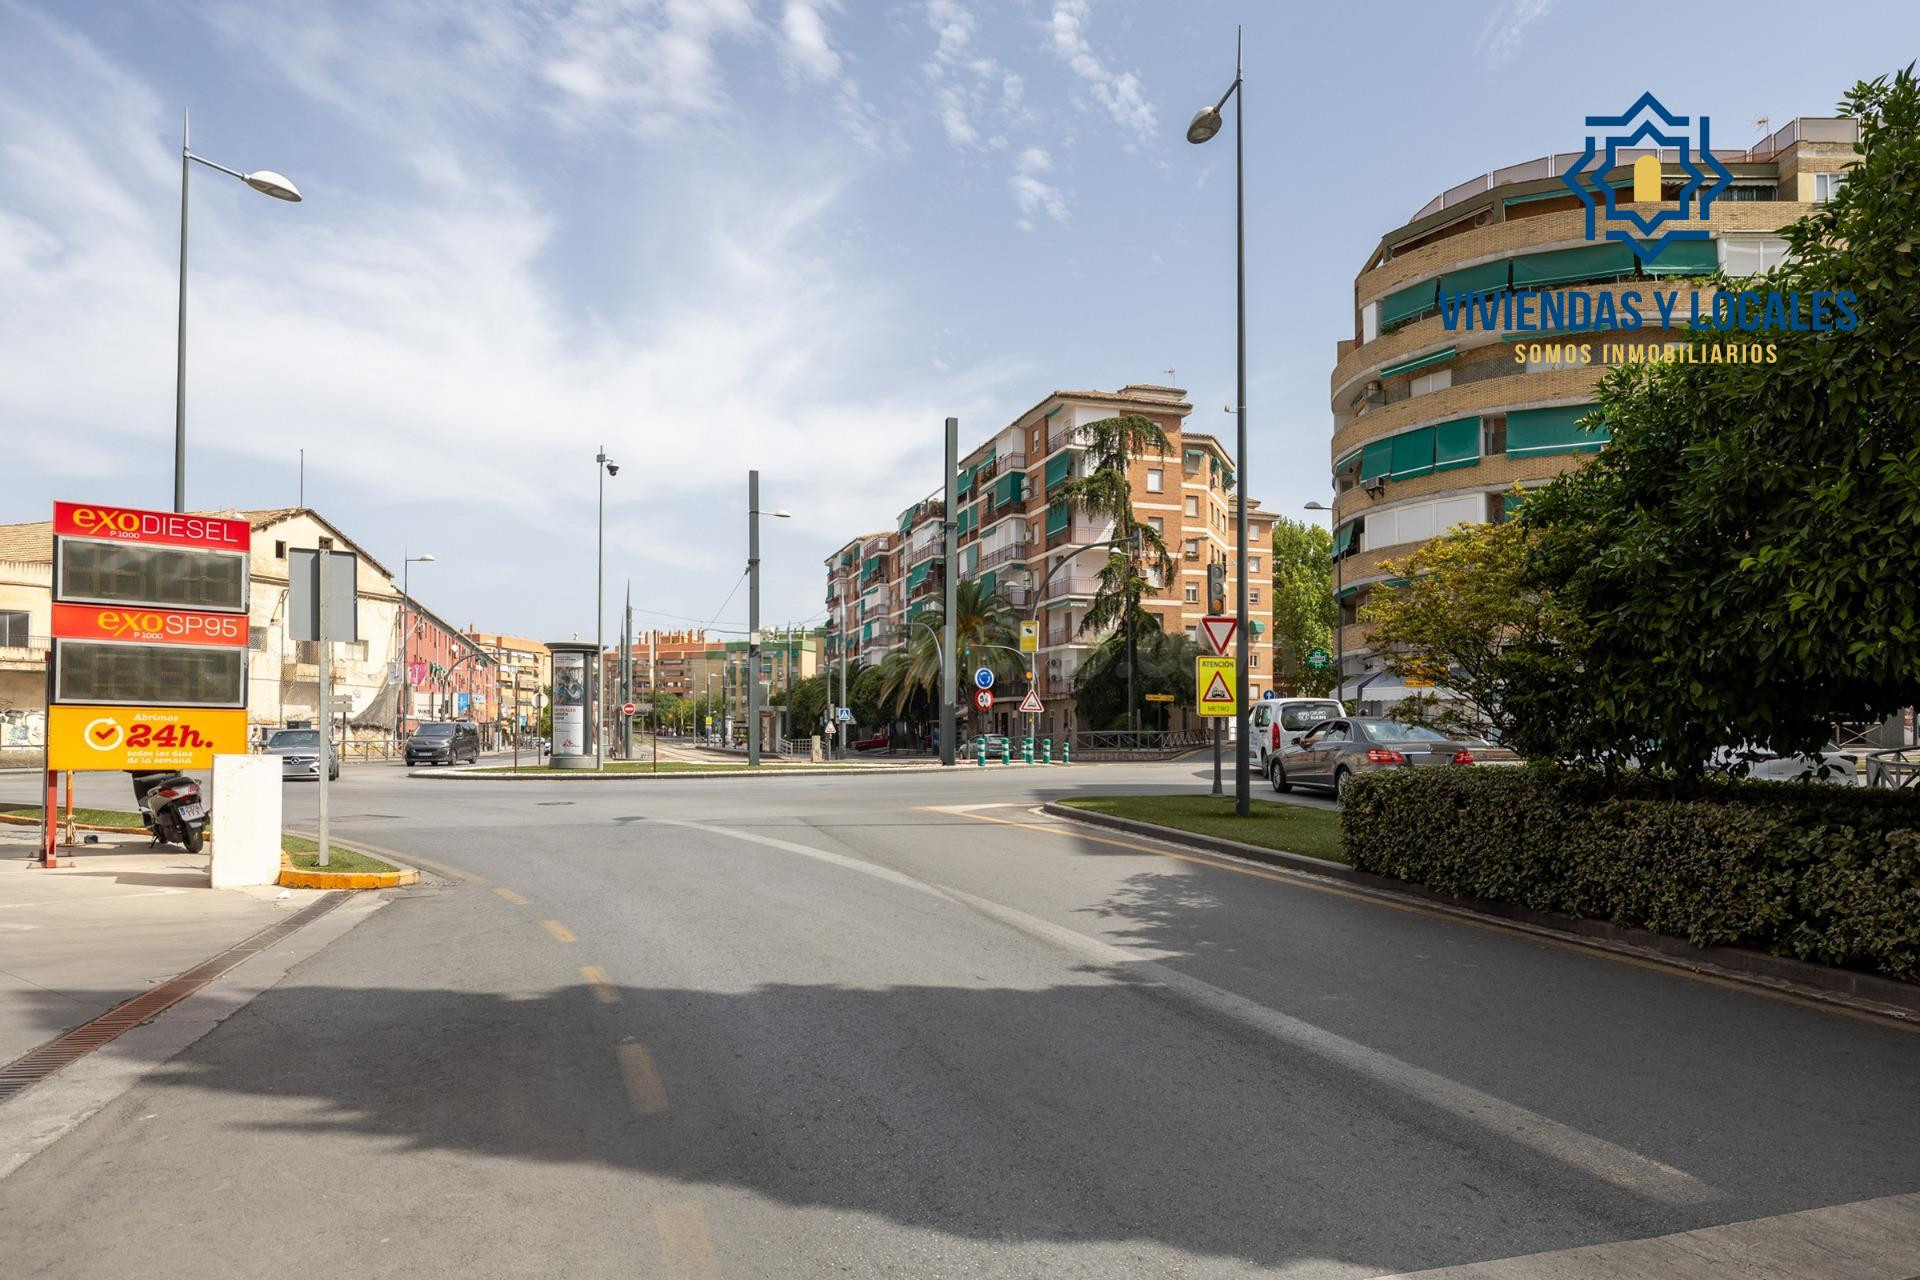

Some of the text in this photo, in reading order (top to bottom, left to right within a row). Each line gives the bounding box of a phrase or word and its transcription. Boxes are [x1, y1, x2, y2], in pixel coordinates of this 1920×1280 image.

[142, 514, 239, 543] DIESEL
[166, 615, 238, 637] SP95
[1202, 660, 1234, 668] ATENCIÓN
[134, 713, 179, 721] Abrimos
[126, 723, 214, 748] 24h.
